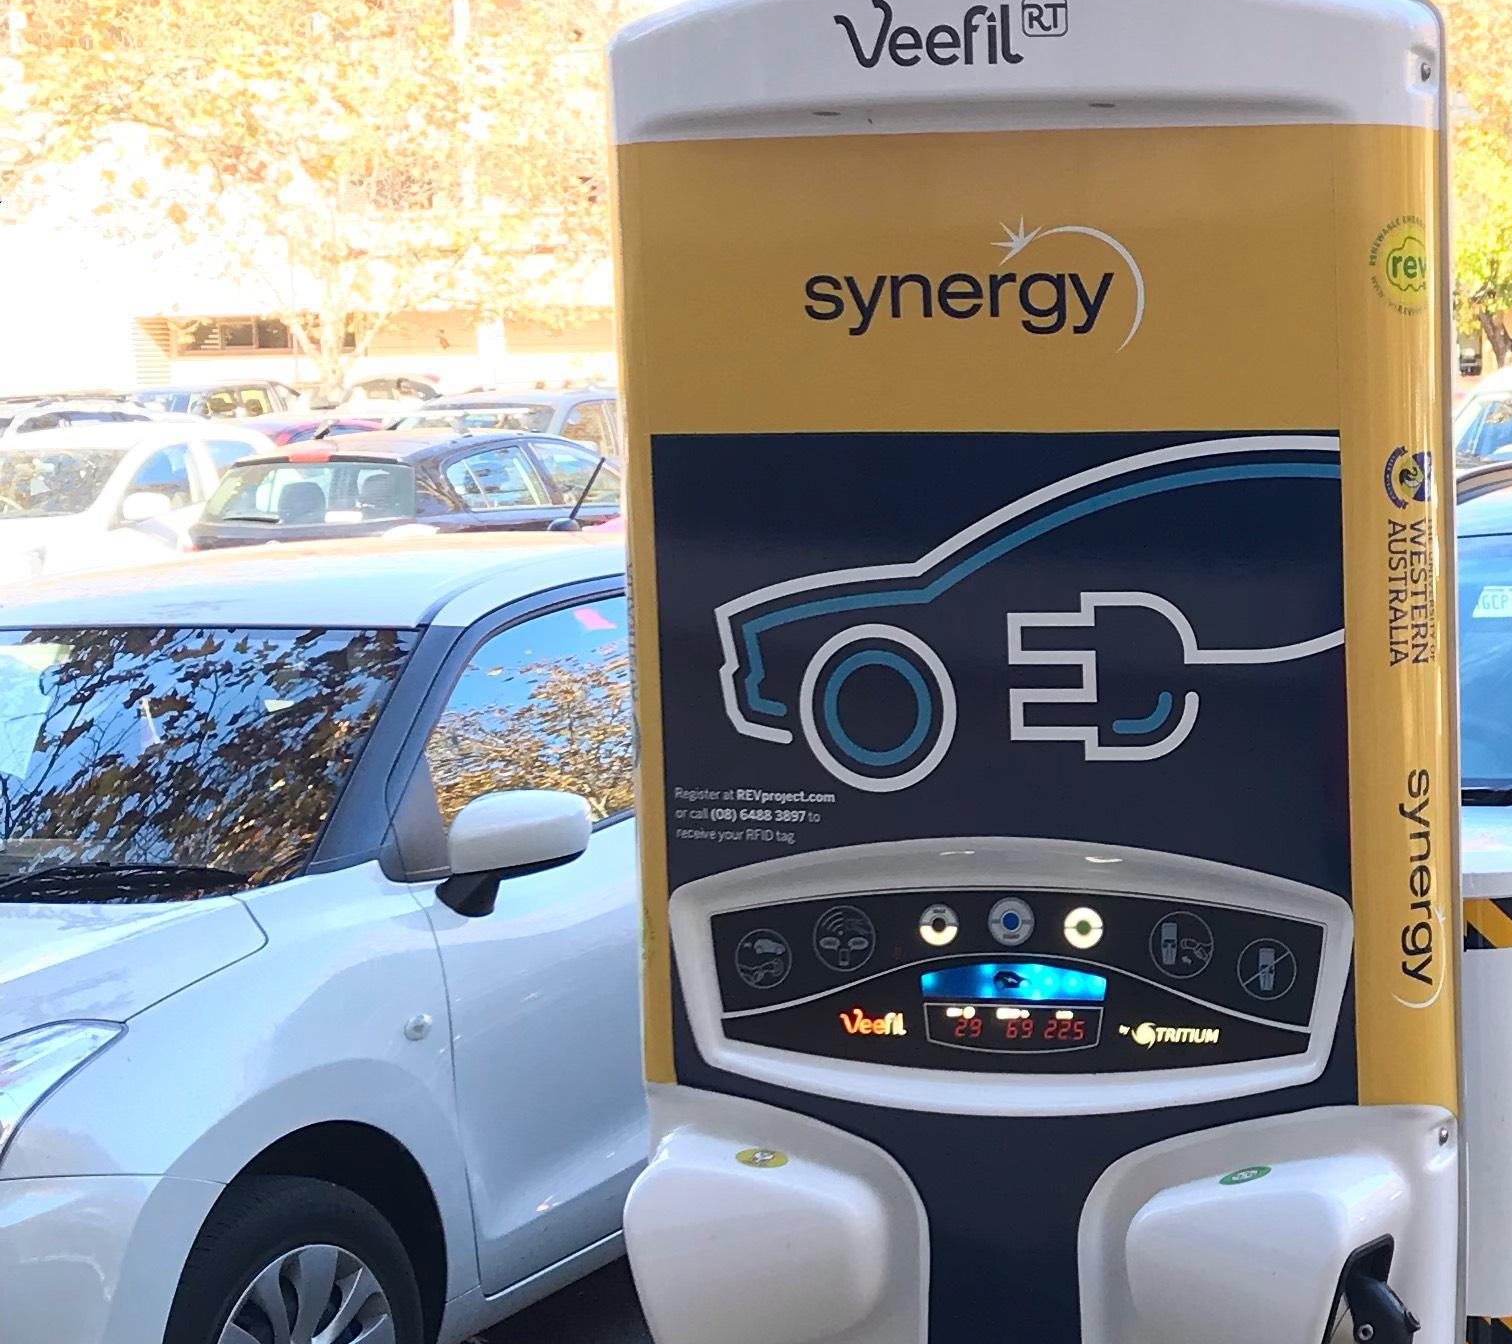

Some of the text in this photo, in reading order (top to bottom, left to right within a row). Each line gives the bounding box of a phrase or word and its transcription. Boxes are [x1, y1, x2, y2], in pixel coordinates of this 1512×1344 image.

[1023, 2, 1068, 32] RT
[804, 272, 1115, 336] synergy
[1387, 518, 1409, 667] AUSTRALIA
[1410, 517, 1428, 664] WESTERN
[674, 787, 835, 804] Register at REVproject.com
[674, 809, 688, 819] or
[689, 807, 709, 819] call
[710, 808, 737, 822] (08)
[739, 808, 773, 822] 6488
[808, 811, 821, 823] to
[676, 827, 796, 845] receive your RFID tag
[1398, 768, 1433, 986] synergy
[840, 1008, 907, 1036] Veefil
[1155, 1027, 1220, 1044] TRITIUM
